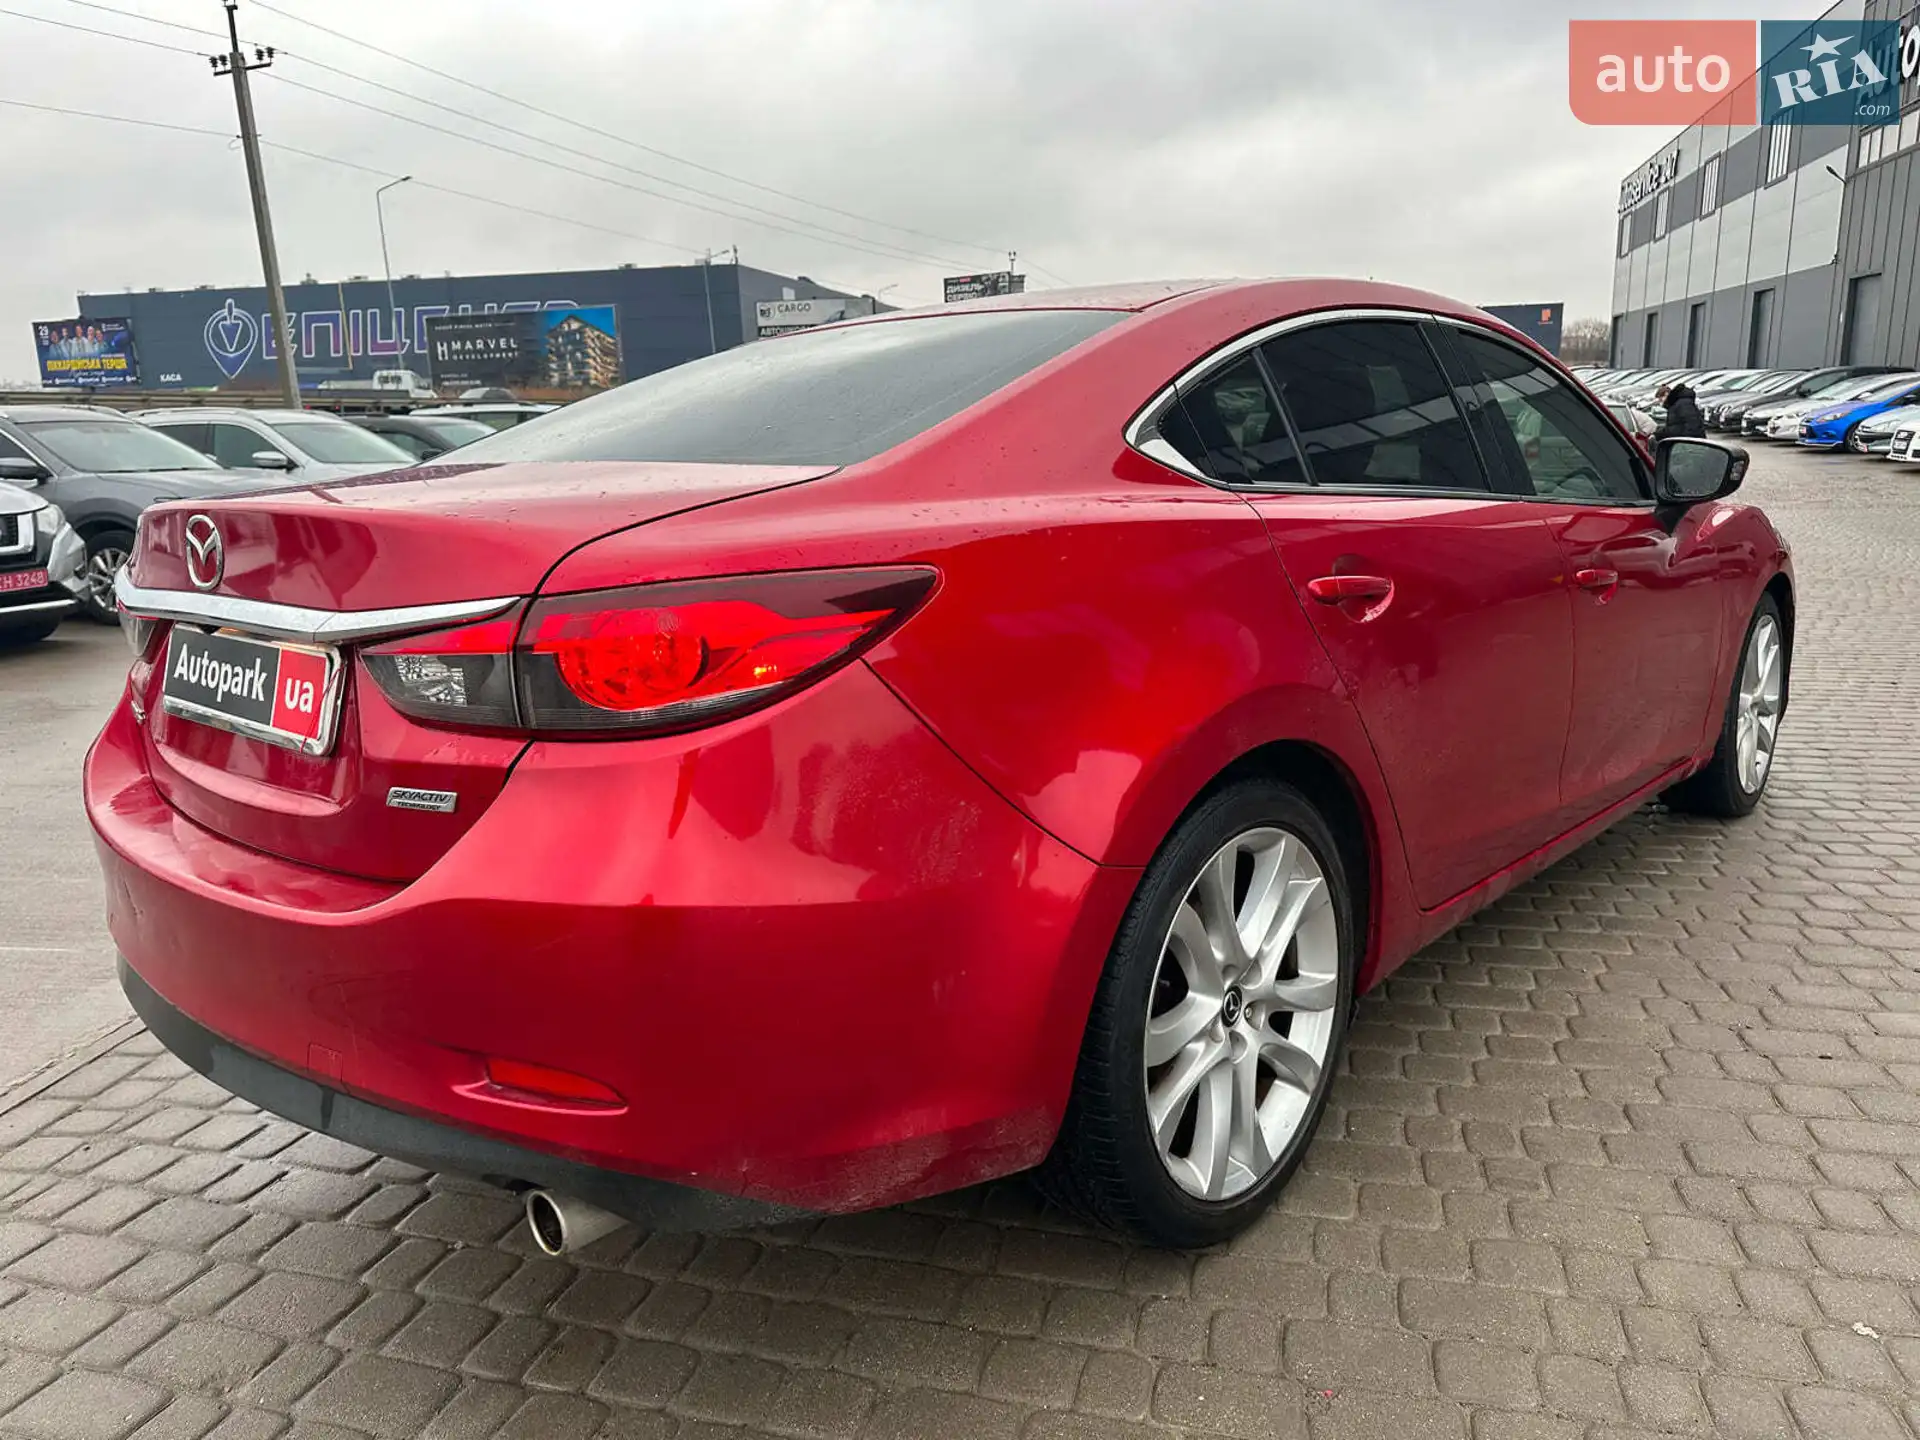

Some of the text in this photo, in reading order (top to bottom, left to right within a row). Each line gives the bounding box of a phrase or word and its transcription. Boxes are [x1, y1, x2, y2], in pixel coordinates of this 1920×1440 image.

[777, 303, 811, 313] CARGO
[451, 338, 518, 351] MARVEL
[160, 373, 182, 383] КАСА
[16, 570, 45, 587] 3248
[173, 643, 314, 714] Autopark ua
[392, 790, 448, 802] SKYACTIV
